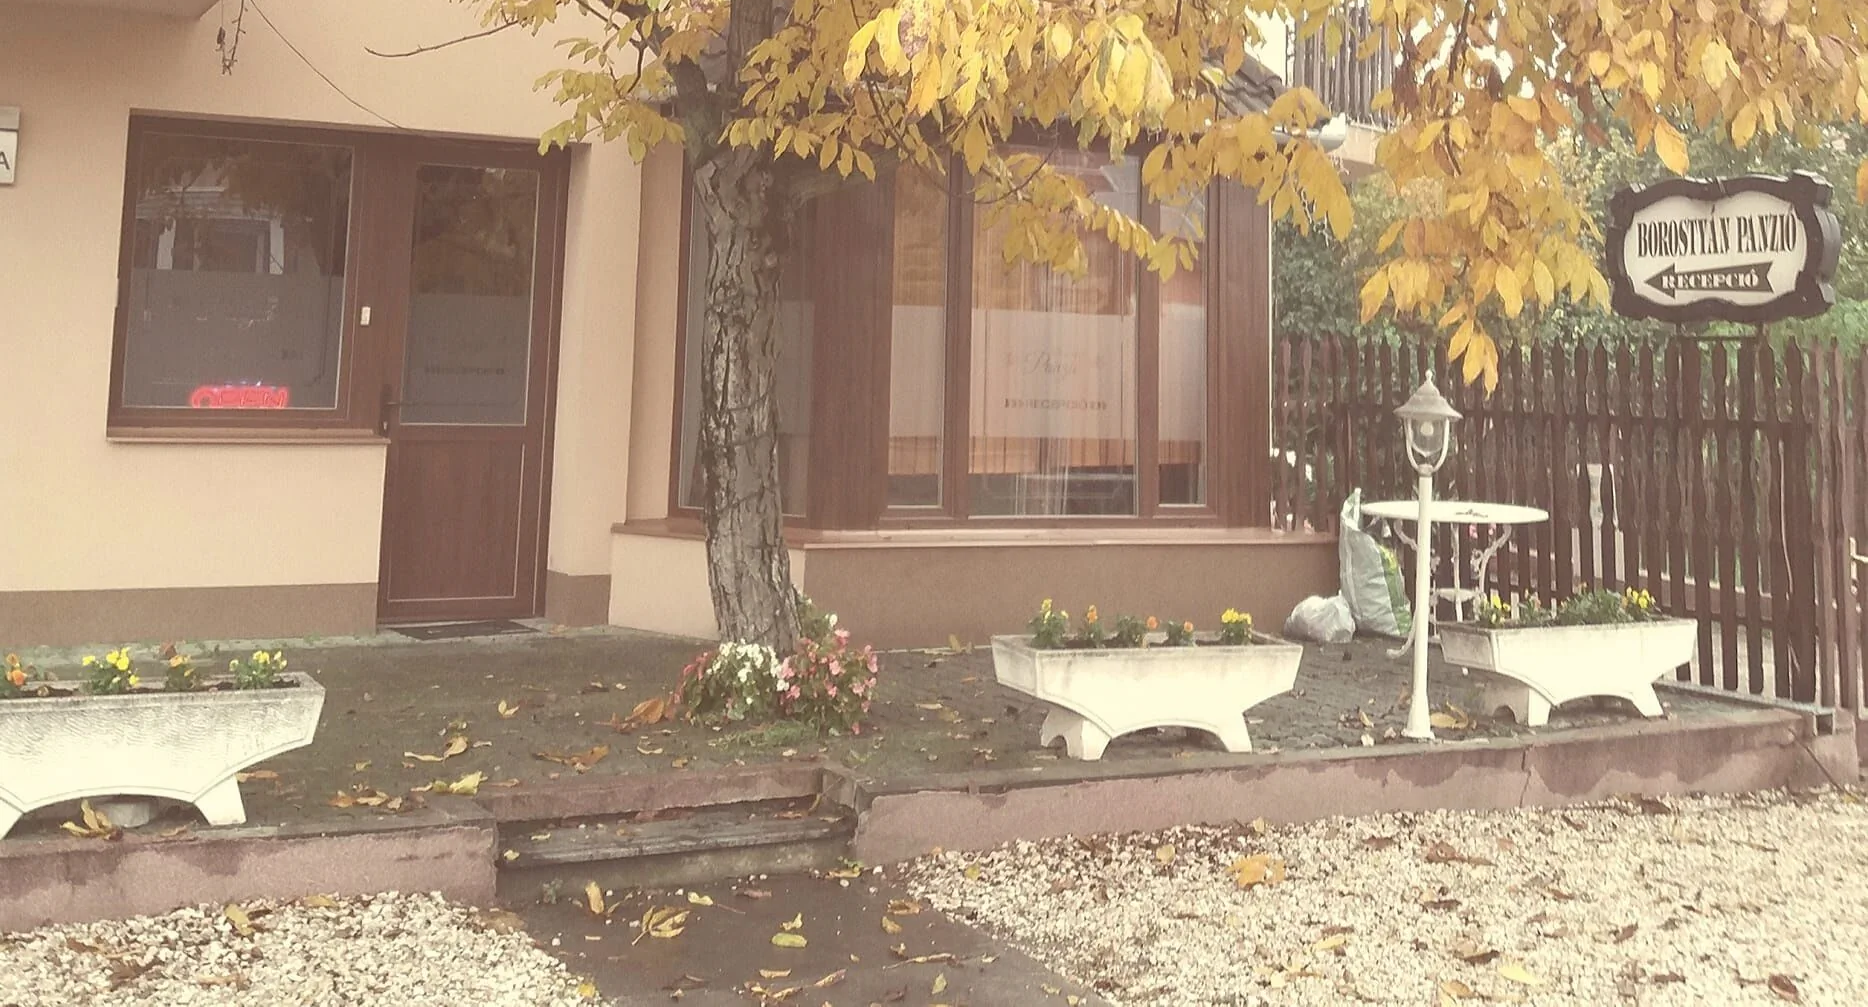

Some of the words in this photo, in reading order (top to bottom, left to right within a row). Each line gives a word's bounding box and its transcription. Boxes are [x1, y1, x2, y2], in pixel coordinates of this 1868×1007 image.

[1637, 203, 1730, 258] BOROSTYÁN
[1736, 202, 1797, 253] PANZIÓ
[1661, 268, 1759, 289] RECEPCIÓ
